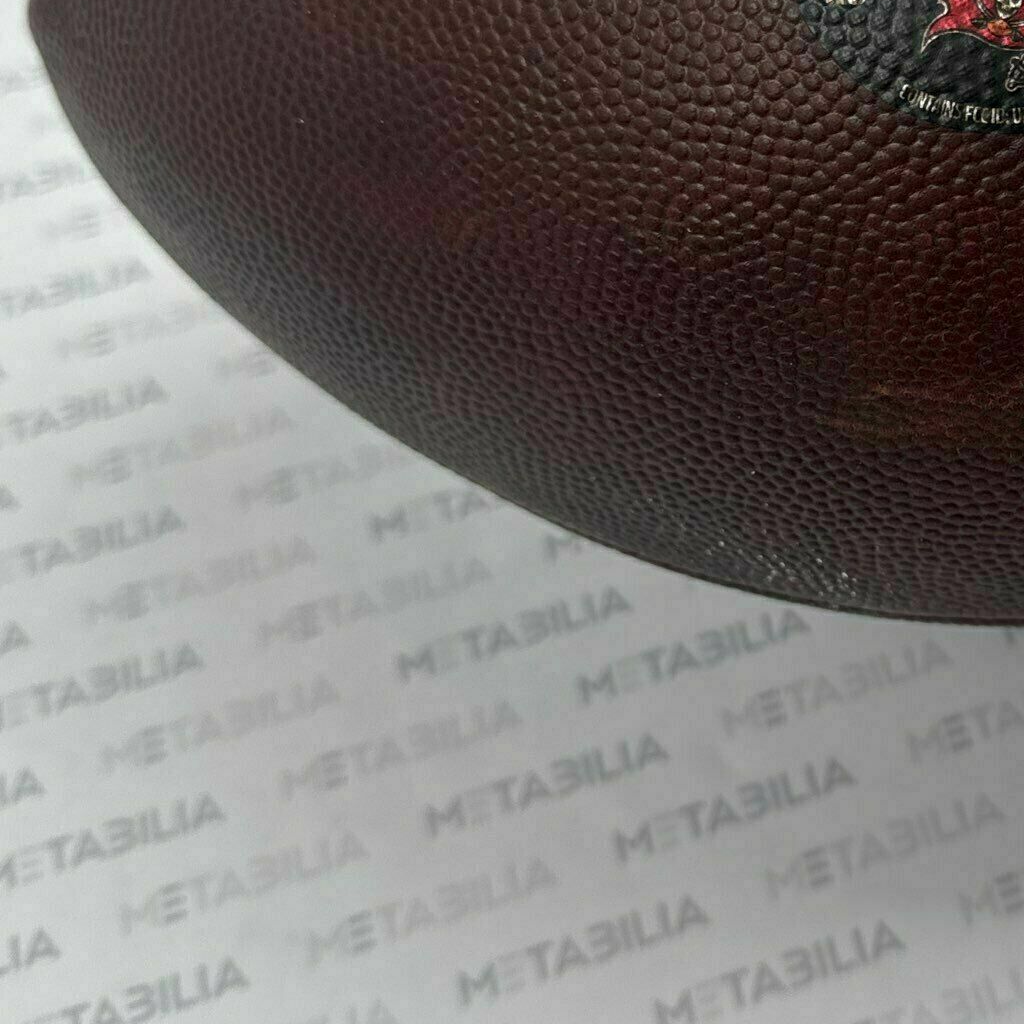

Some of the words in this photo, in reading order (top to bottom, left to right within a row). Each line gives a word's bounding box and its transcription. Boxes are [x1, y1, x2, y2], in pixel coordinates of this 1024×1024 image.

[900, 83, 962, 119] CONTAINS
[964, 105, 988, 124] FCC
[0, 377, 170, 443] TABILIA
[396, 586, 634, 683] METABILIA
[576, 608, 812, 707] METABILIA
[422, 732, 671, 839] METABILIA
[610, 756, 859, 865] METABILIA
[455, 892, 713, 1009] METABILIA
